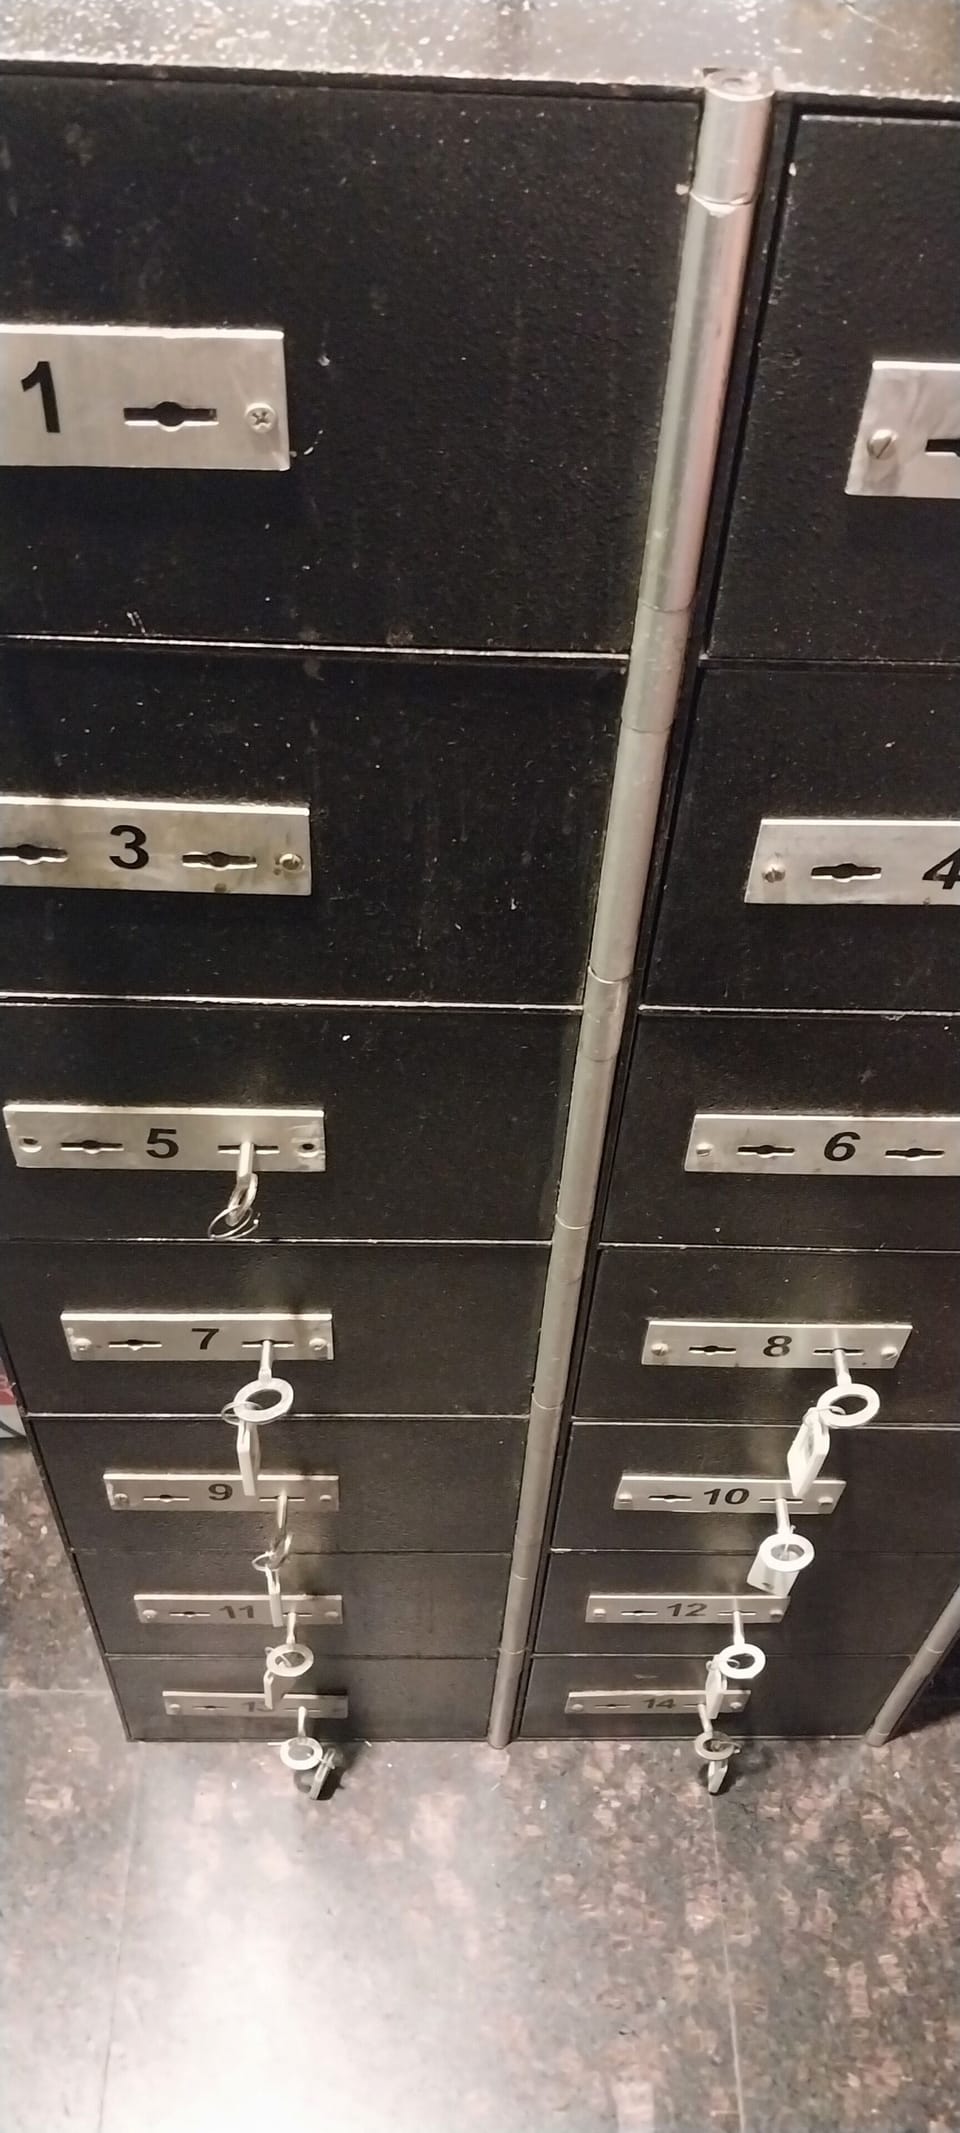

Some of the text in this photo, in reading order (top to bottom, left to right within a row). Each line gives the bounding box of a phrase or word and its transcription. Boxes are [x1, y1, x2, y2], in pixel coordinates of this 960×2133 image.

[21, 361, 60, 433] 1
[110, 825, 149, 869] 3
[922, 848, 960, 889] 4
[146, 1128, 178, 1158] 5
[824, 1132, 860, 1161] 6
[192, 1328, 219, 1349] 7
[763, 1336, 792, 1357] 8
[208, 1484, 232, 1500] 9
[704, 1488, 749, 1505] 10
[220, 1606, 254, 1619] 11
[667, 1603, 706, 1616] 12
[644, 1699, 675, 1709] 14
